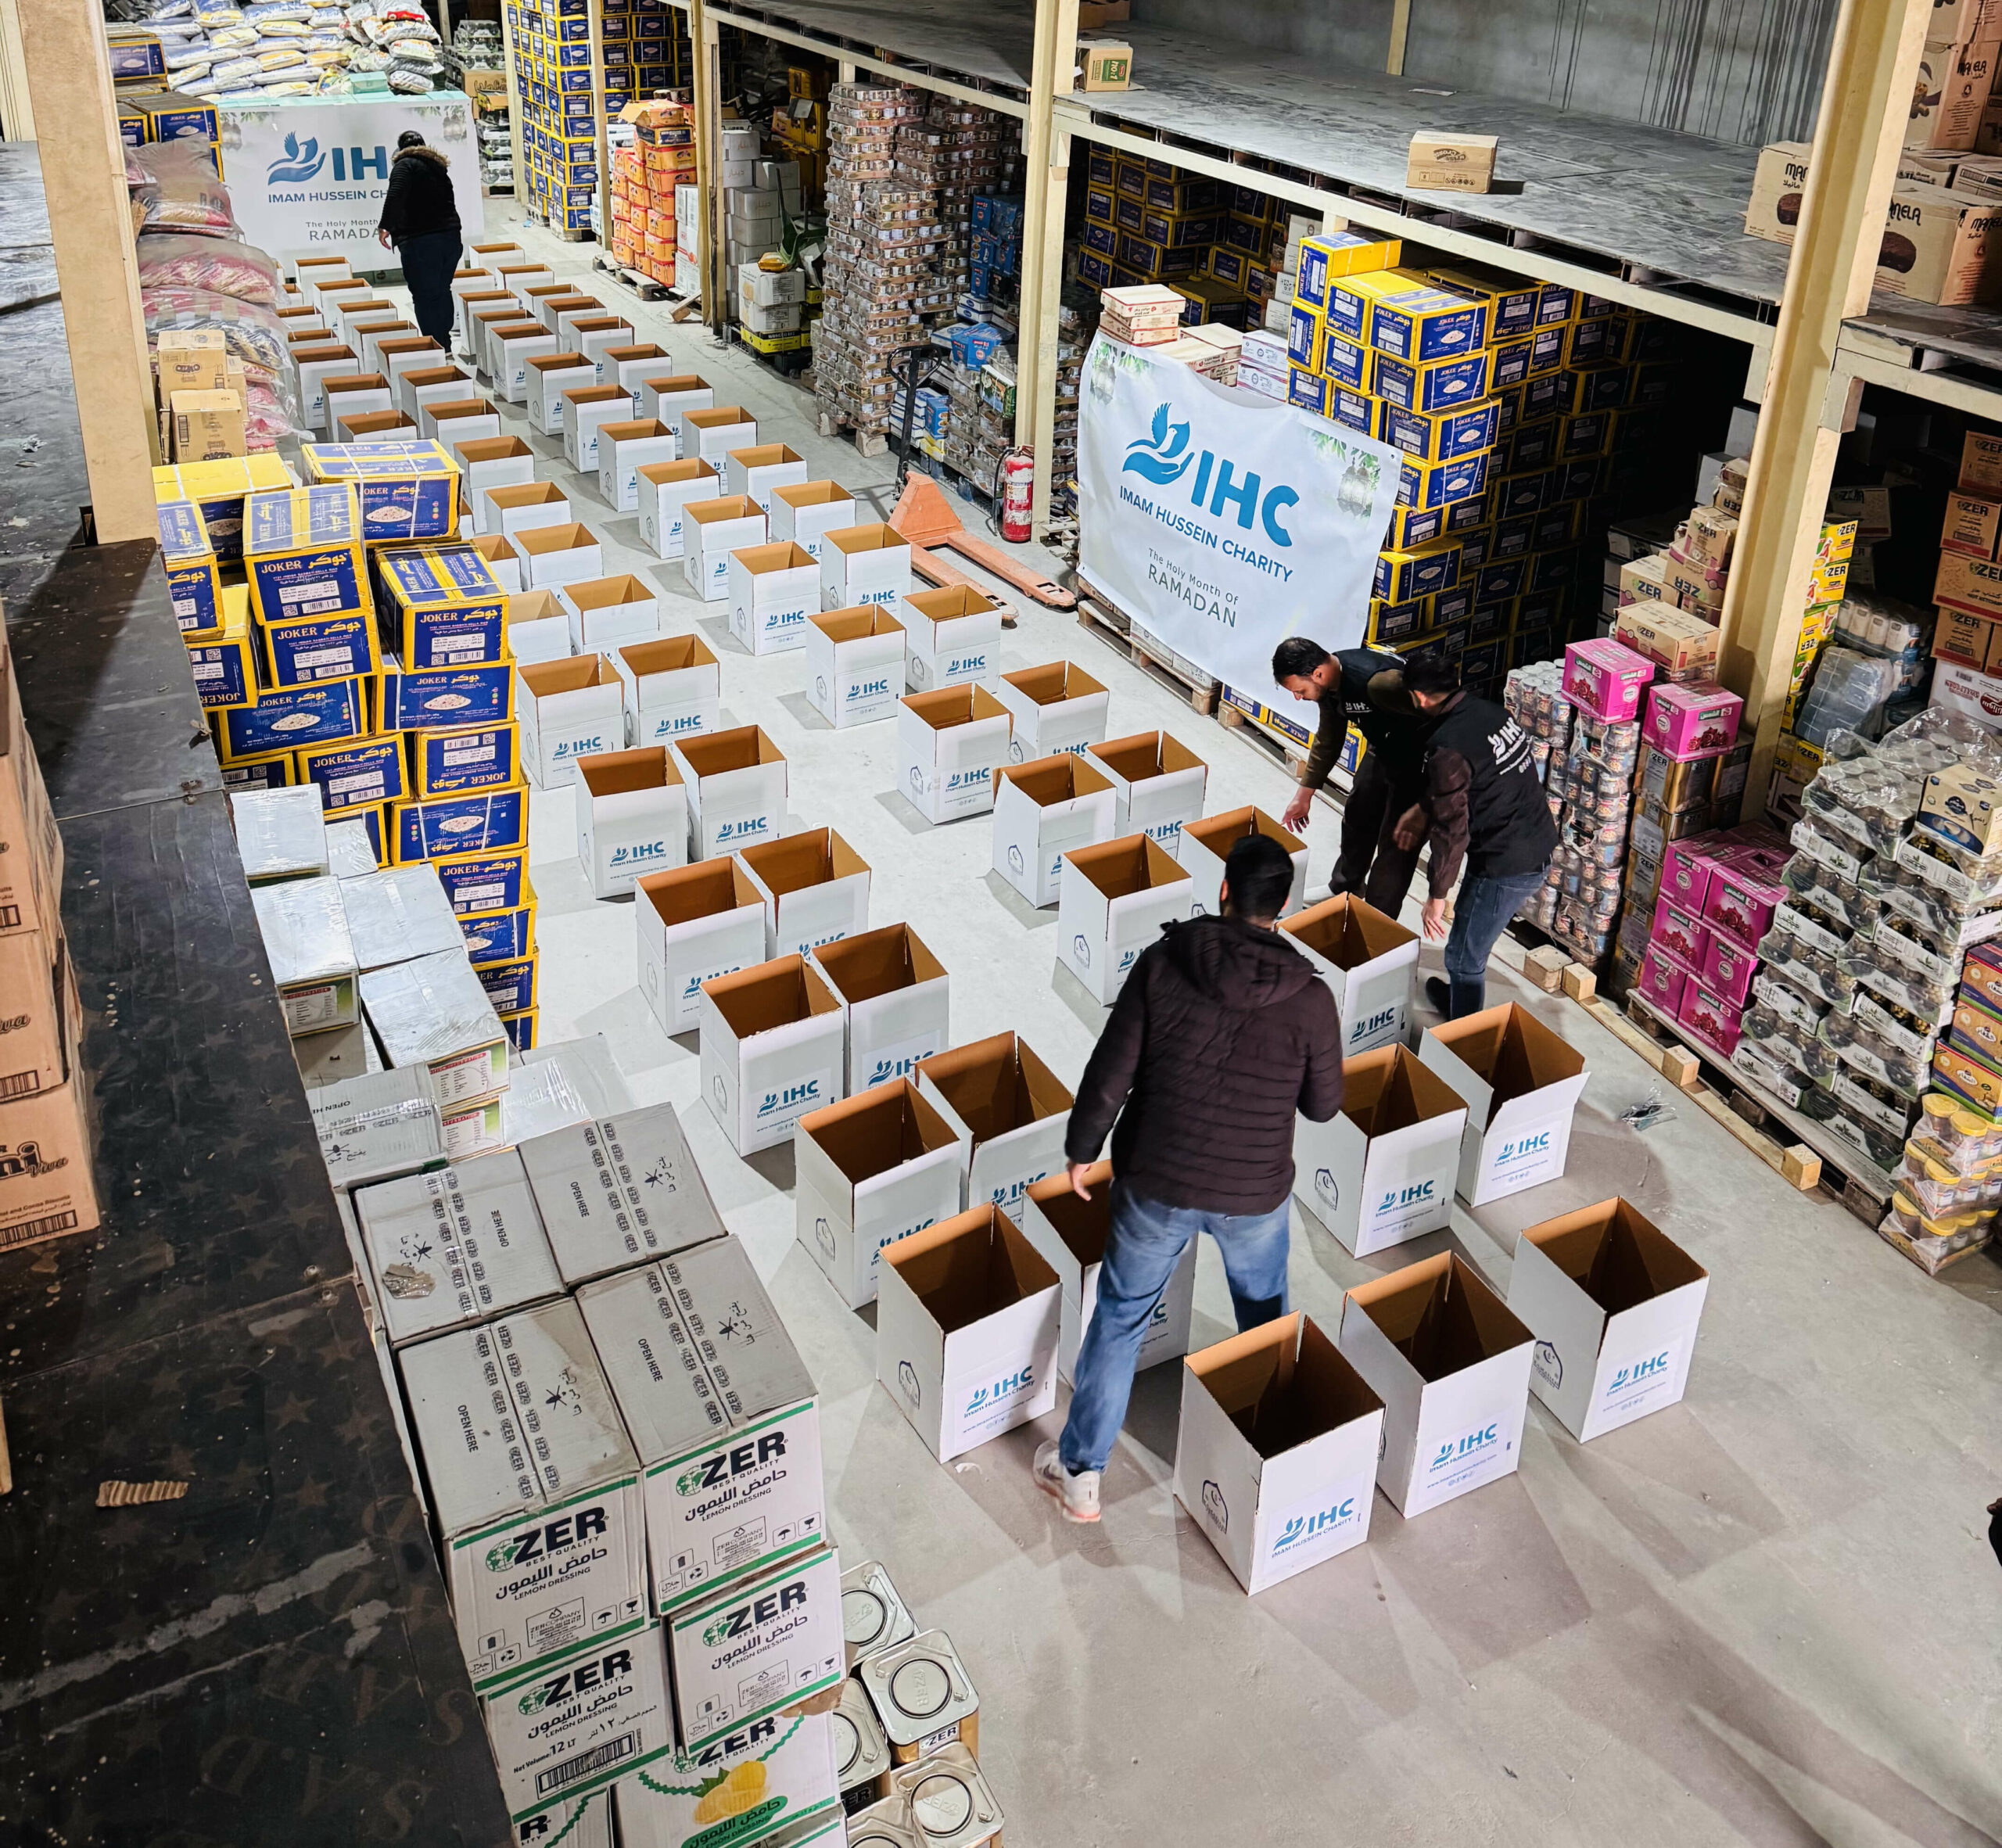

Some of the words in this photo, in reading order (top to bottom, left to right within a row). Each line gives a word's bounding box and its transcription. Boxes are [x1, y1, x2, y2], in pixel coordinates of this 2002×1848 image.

[332, 146, 389, 181] IH
[268, 193, 305, 203] IMAM
[309, 190, 366, 202] HUSSEIN
[310, 228, 381, 241] RAMADA
[1191, 450, 1300, 547] IHC
[1963, 501, 1989, 516] ZER
[1119, 485, 1153, 515] IMAM
[1156, 506, 1218, 548] HUSSEIN
[1222, 540, 1293, 582] CHARITY
[1840, 523, 1856, 535] ZER
[261, 560, 302, 573] JOKER
[308, 552, 347, 569] جوكر
[1828, 565, 1846, 577] ZER
[1149, 547, 1164, 564] The
[1166, 560, 1186, 580] Holy
[1189, 573, 1221, 597] Month
[1225, 593, 1239, 605] Of
[1674, 576, 1701, 598] ZER
[873, 590, 895, 603] IHC
[1149, 563, 1236, 628] RAMADAN
[1637, 580, 1662, 600] ZER
[420, 612, 457, 623] JOKER
[463, 608, 498, 622] جوكر
[782, 610, 804, 623] IHC
[1955, 610, 1979, 628] ZER
[278, 627, 318, 640] JOKER
[323, 621, 361, 635] جوكر
[1640, 626, 1656, 640] ZER
[1801, 638, 1816, 650] ZER
[963, 656, 985, 669] IHC
[417, 676, 447, 685] JOKER
[863, 680, 888, 694] IHC
[260, 697, 292, 708] JOKER
[674, 715, 701, 730] IHC
[573, 736, 601, 752] IHC
[1802, 748, 1820, 763] ZER
[314, 754, 351, 768] JOKER
[1652, 753, 1667, 766] ZER
[471, 772, 506, 784] JOKER
[964, 767, 990, 783] IHC
[737, 816, 767, 834] IHC
[633, 841, 664, 858] IHC
[443, 865, 479, 876] JOKER
[1641, 858, 1655, 871] ZER
[1369, 1007, 1394, 1030] IHC
[783, 1079, 819, 1104] IHC
[757, 1107, 774, 1119] Imam
[776, 1100, 799, 1112] Hussein
[799, 1093, 820, 1104] Charity
[1519, 1132, 1550, 1154] IHC
[570, 1181, 583, 1200] OPEN
[577, 1198, 590, 1218] HERE
[1401, 1179, 1434, 1204] IHC
[497, 1228, 510, 1247] OPEN
[638, 1338, 653, 1361] OPEN
[648, 1359, 663, 1382] HERE
[1634, 1351, 1669, 1379] IHC
[994, 1365, 1032, 1398] IHC
[964, 1405, 983, 1419] Imam
[985, 1392, 1010, 1409] Hussein
[1011, 1380, 1035, 1395] Charity
[457, 1405, 471, 1429] OPEN
[465, 1428, 479, 1452] HERE
[1459, 1423, 1498, 1453] IHC
[701, 1431, 786, 1490] ZER
[1430, 1461, 1449, 1473] Imam
[1450, 1448, 1475, 1464] Hussein
[1476, 1437, 1498, 1452] Charity
[712, 1477, 736, 1491] BEST
[740, 1459, 779, 1479] QUALITY
[742, 1469, 787, 1496] حامض
[685, 1487, 737, 1522] الليمون
[701, 1505, 731, 1521] LEMON
[732, 1487, 771, 1509] DRESSING
[1308, 1497, 1354, 1534] IHC
[513, 1506, 607, 1565] ZER
[1272, 1545, 1291, 1559] IMAM
[1292, 1531, 1322, 1549] HUSSEIN
[1322, 1516, 1352, 1534] CHARITY
[526, 1553, 552, 1567] BEST
[555, 1536, 600, 1556] QUALITY
[558, 1548, 608, 1573] حامض
[495, 1564, 552, 1600] الليمون
[515, 1583, 546, 1600] LEMON
[548, 1566, 590, 1588] DRESSING
[726, 1581, 807, 1639] ZER
[737, 1625, 759, 1639] BEST
[763, 1606, 801, 1627] QUALITY
[766, 1616, 808, 1642] حامض
[712, 1634, 761, 1670] الليمون
[727, 1652, 755, 1669] LEMON
[756, 1634, 793, 1655] DRESSING
[544, 1649, 632, 1707] ZER
[556, 1695, 580, 1708] BEST
[583, 1674, 625, 1695] QUALITY
[587, 1685, 633, 1712] حامض
[528, 1704, 581, 1739] الليمون
[546, 1722, 575, 1739] LEMON
[577, 1703, 618, 1724] DRESSING
[698, 1717, 776, 1766] ZER
[929, 1727, 956, 1746] ZER
[514, 1764, 526, 1774] Net
[549, 1742, 565, 1756] 12
[567, 1739, 576, 1749] LT
[708, 1756, 730, 1768] BEST
[733, 1738, 770, 1756] QUALITY
[741, 1800, 781, 1825] حامض
[731, 1815, 771, 1837] DRESSING
